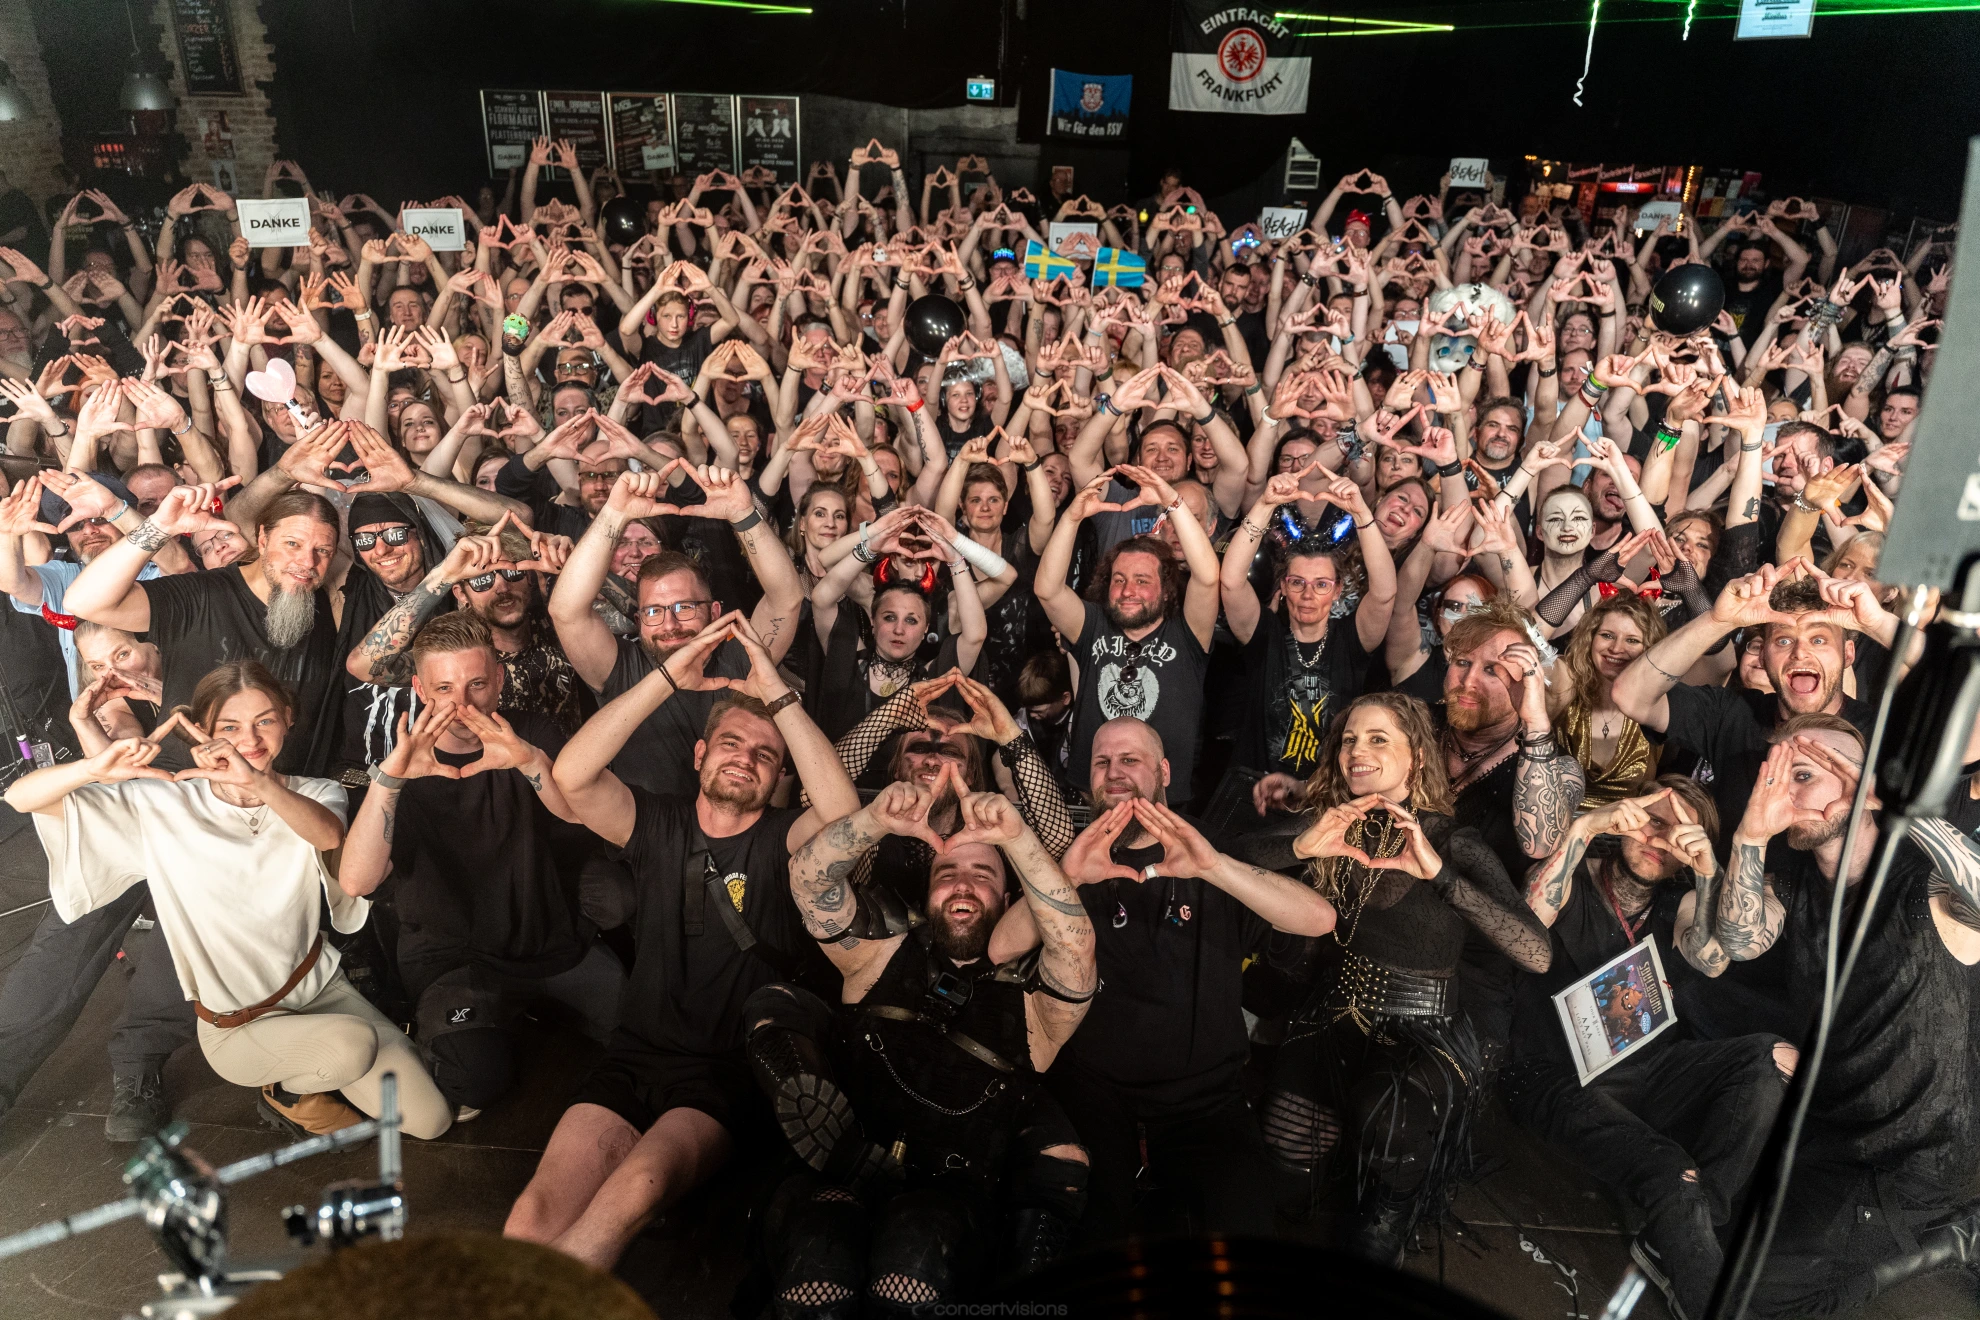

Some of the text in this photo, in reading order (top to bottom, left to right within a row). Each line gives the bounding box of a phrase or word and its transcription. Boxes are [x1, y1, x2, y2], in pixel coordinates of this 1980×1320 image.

[1200, 7, 1290, 39] EINTRACHT
[1196, 69, 1284, 102] FRANKFURT
[653, 96, 665, 113] 5
[1057, 117, 1072, 133] Wir
[1088, 123, 1105, 136] den
[1106, 122, 1123, 136] FSV
[250, 218, 300, 229] DANKE
[412, 226, 454, 235] DANKE
[355, 531, 404, 547] KISS ME
[472, 575, 492, 588] KISS
[1049, 885, 1071, 896] CEAN
[1639, 960, 1662, 1015] SOULBOUND
